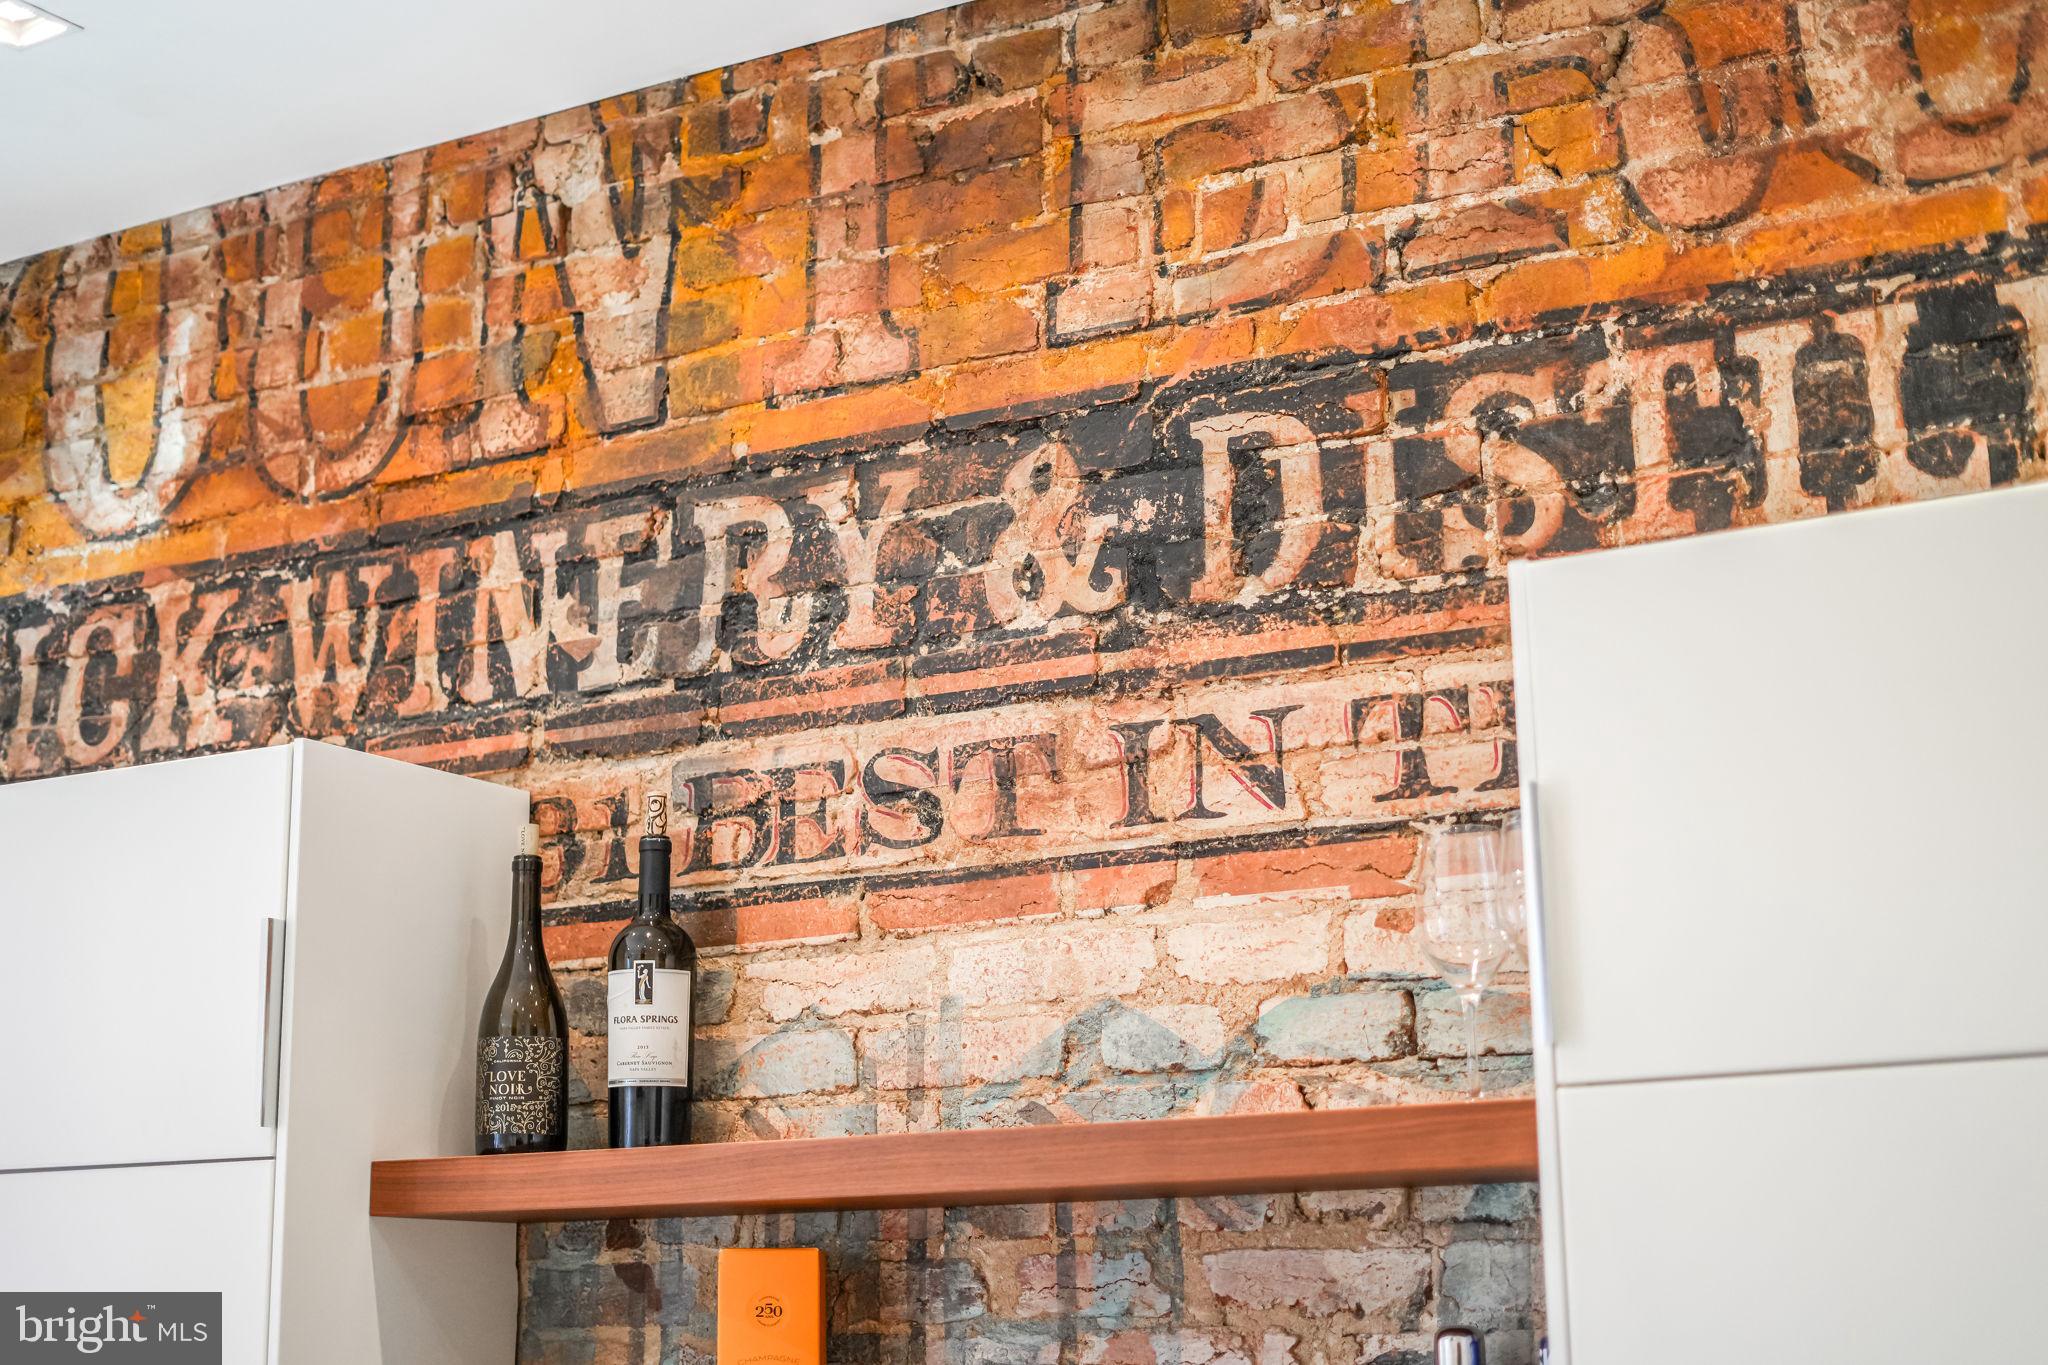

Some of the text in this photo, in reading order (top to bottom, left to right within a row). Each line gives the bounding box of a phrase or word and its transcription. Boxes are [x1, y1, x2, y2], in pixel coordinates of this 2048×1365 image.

[278, 468, 922, 732] WINERY
[984, 442, 1126, 628] &
[677, 731, 1055, 876] BEST
[1107, 704, 1304, 830] IN
[613, 1014, 679, 1025] FLORA SPRINGS
[485, 1070, 526, 1083] LOVE
[489, 1083, 533, 1096] NOIR
[755, 1303, 783, 1318] 250
